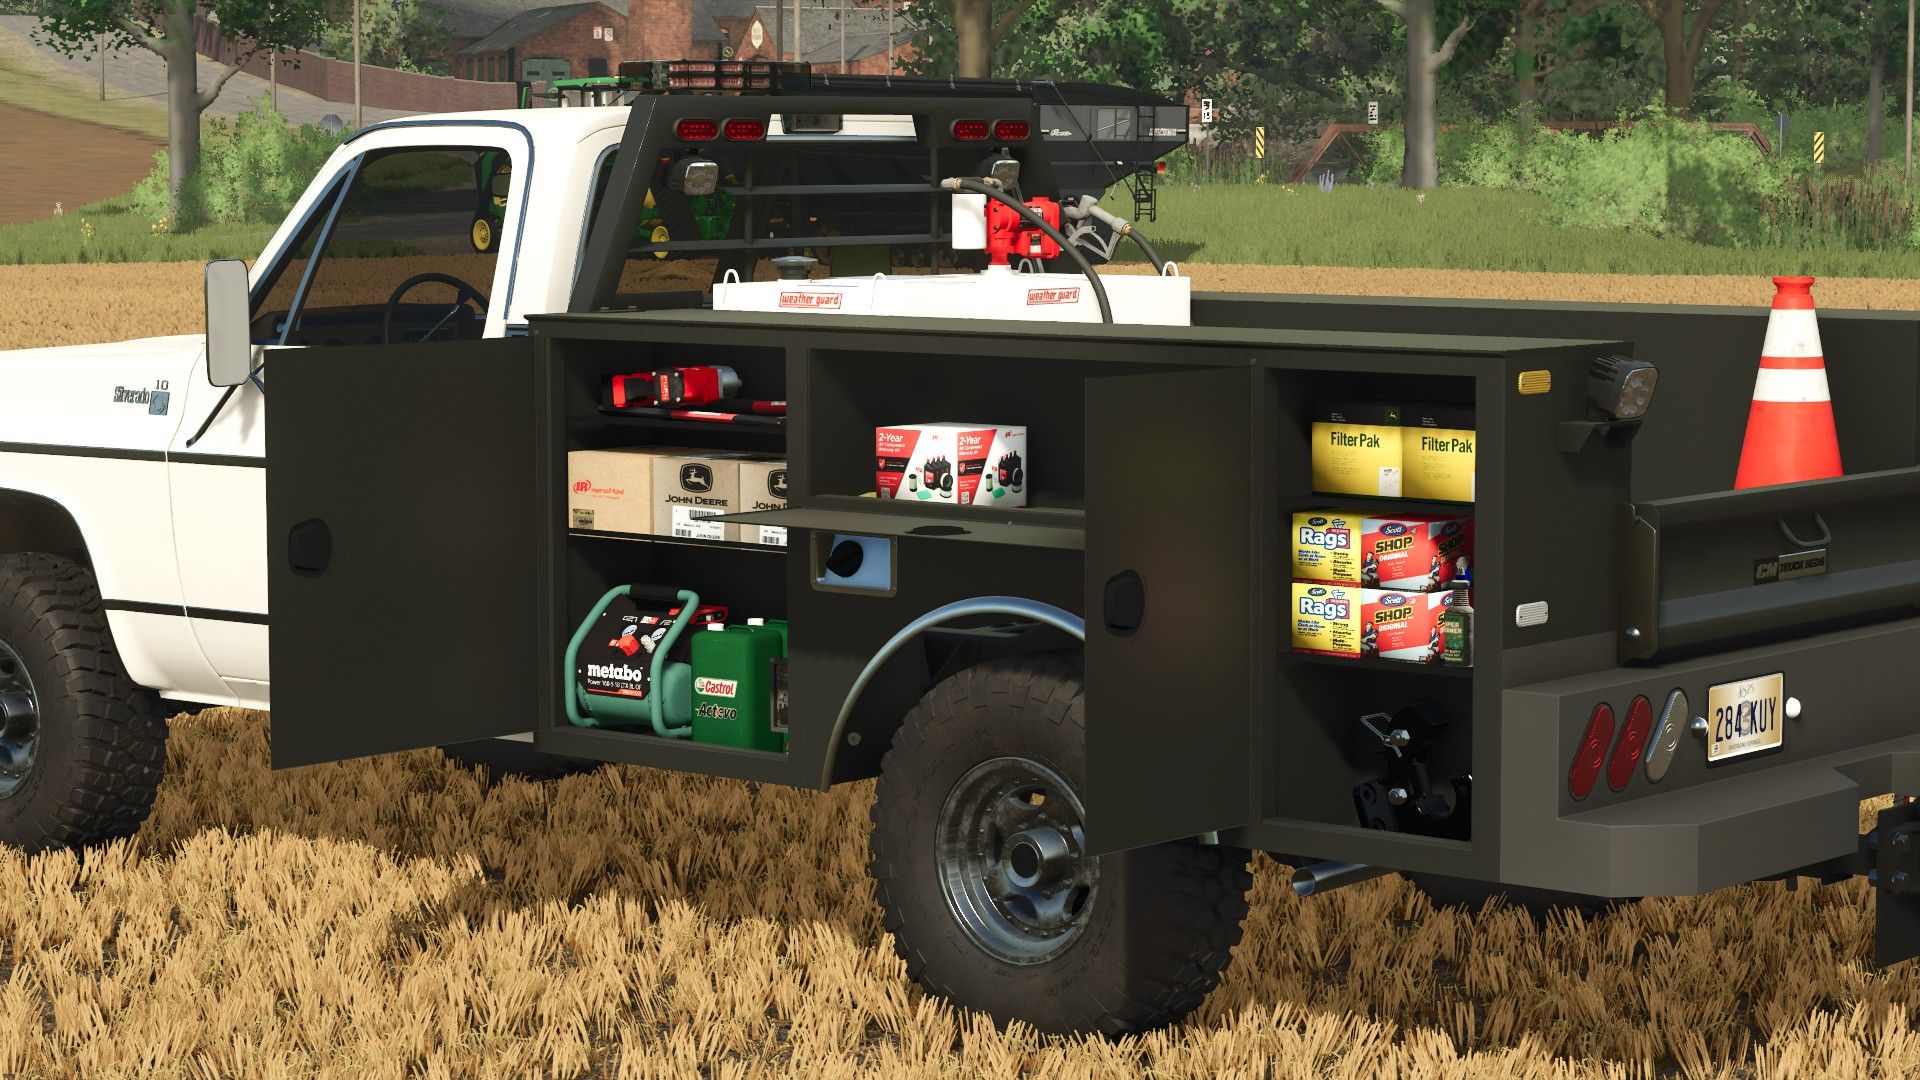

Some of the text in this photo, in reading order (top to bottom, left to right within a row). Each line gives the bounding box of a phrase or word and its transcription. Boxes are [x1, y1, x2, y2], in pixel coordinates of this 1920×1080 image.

[782, 294, 840, 306] weather guard
[1029, 290, 1077, 301] weather guard
[156, 379, 169, 391] 10
[878, 432, 904, 443] 2-Year
[959, 436, 982, 446] 2-Year
[1330, 431, 1380, 448] Filter Pak
[1421, 436, 1473, 454] Filter Pak
[665, 494, 728, 507] JOHN DEERE
[752, 501, 783, 511] JOHN
[1385, 526, 1403, 535] Scott
[1300, 527, 1348, 550] Rags
[1376, 536, 1413, 553] SHOP
[1379, 551, 1408, 561] ORIGINAL
[1779, 560, 1804, 573] TRUCK
[1385, 596, 1403, 605] Scott
[1299, 597, 1347, 620] Rags
[1375, 606, 1412, 623] SHOP
[1378, 621, 1408, 632] ORIGINAL
[587, 664, 642, 682] metabo
[705, 680, 734, 695] Castrol
[696, 702, 738, 720] Actevo
[1715, 697, 1776, 743] 284 KUY
